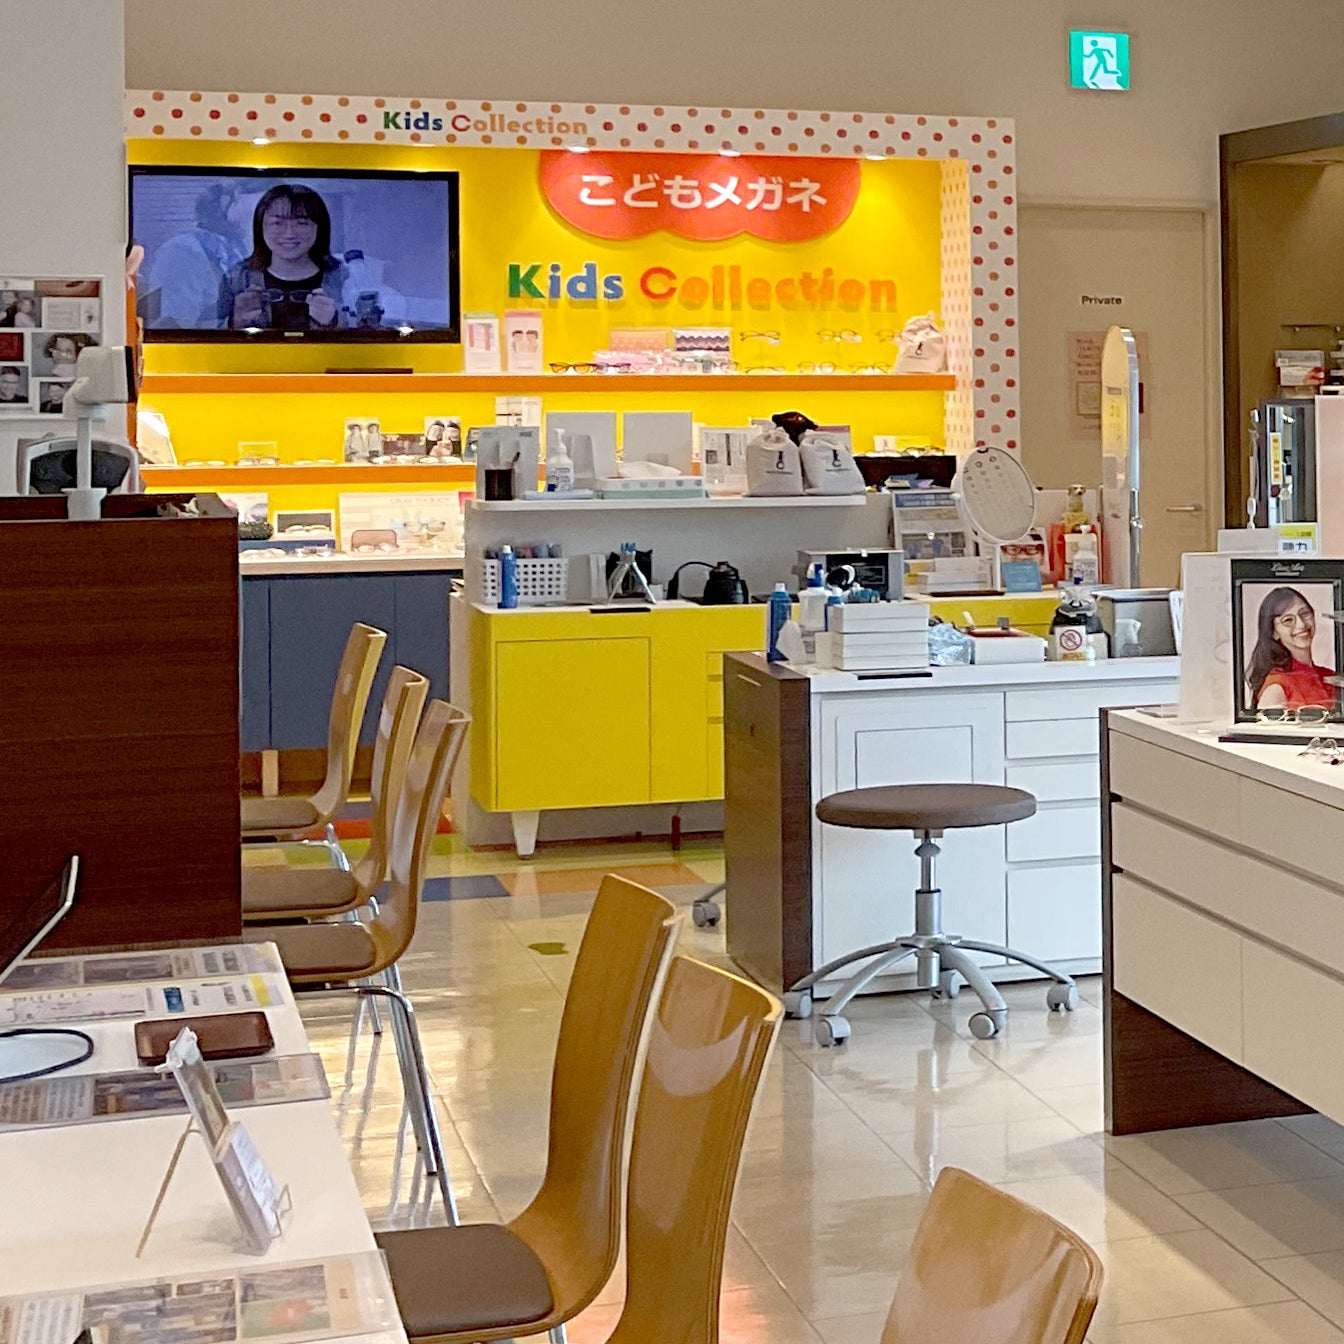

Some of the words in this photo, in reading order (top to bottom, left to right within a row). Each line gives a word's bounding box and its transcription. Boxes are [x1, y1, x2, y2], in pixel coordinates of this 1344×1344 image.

[383, 111, 443, 131] Kids
[451, 113, 587, 134] Collection
[577, 173, 828, 212] こどもメガネ
[507, 262, 624, 300] Kids
[640, 265, 898, 305] Collection
[1081, 295, 1122, 305] Private
